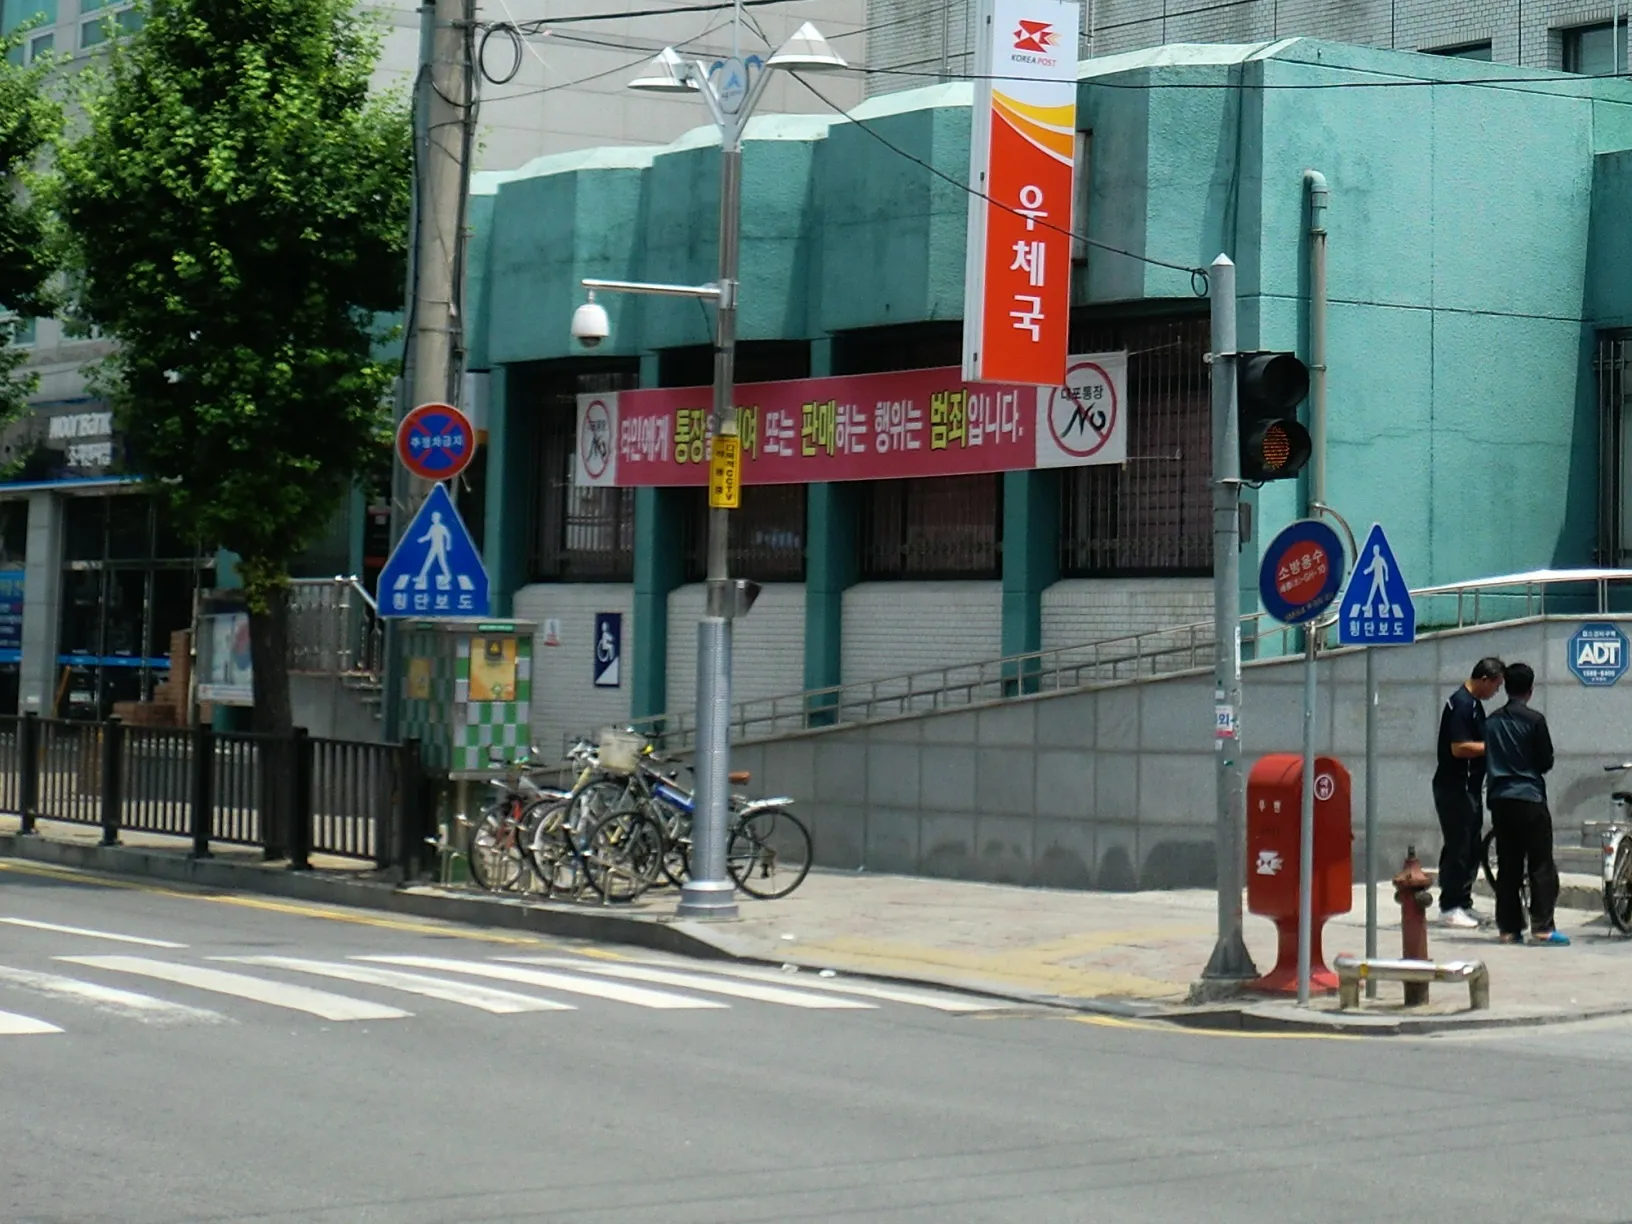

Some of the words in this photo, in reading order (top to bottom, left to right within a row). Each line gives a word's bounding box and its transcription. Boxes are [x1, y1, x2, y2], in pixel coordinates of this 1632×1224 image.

[1011, 54, 1037, 64] KOREA
[1037, 57, 1057, 67] POST
[1009, 184, 1048, 342] 우체국
[763, 408, 795, 457] 또는
[801, 399, 867, 457] 판매하는
[874, 399, 923, 454] 행위는
[930, 388, 1024, 451] 범죄입니다.
[1277, 548, 1325, 581] 소방용수
[392, 592, 475, 611] 횡단보도
[1349, 620, 1404, 637] 횡단보도
[1577, 642, 1621, 665] ADT
